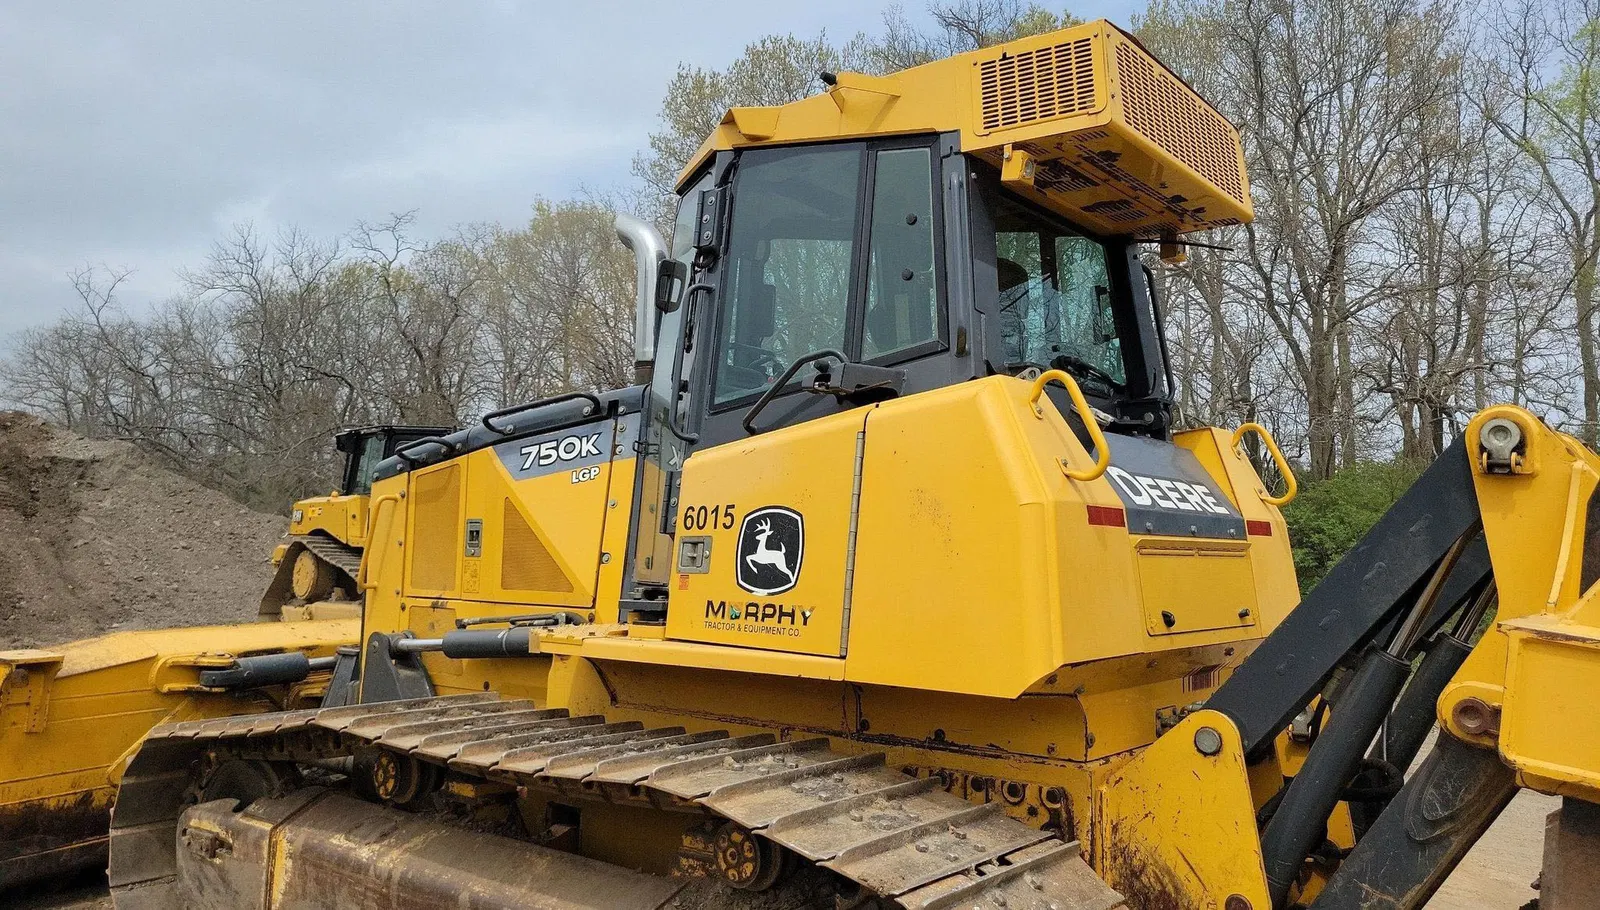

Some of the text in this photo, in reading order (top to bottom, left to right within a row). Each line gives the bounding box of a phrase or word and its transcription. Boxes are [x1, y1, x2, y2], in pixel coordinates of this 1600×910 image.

[520, 432, 602, 471] 750K
[571, 467, 600, 485] LGP
[1106, 466, 1230, 515] DEERE
[683, 504, 736, 531] 6015
[704, 621, 801, 637] TRACTOR & EQUIPMENT CO.
